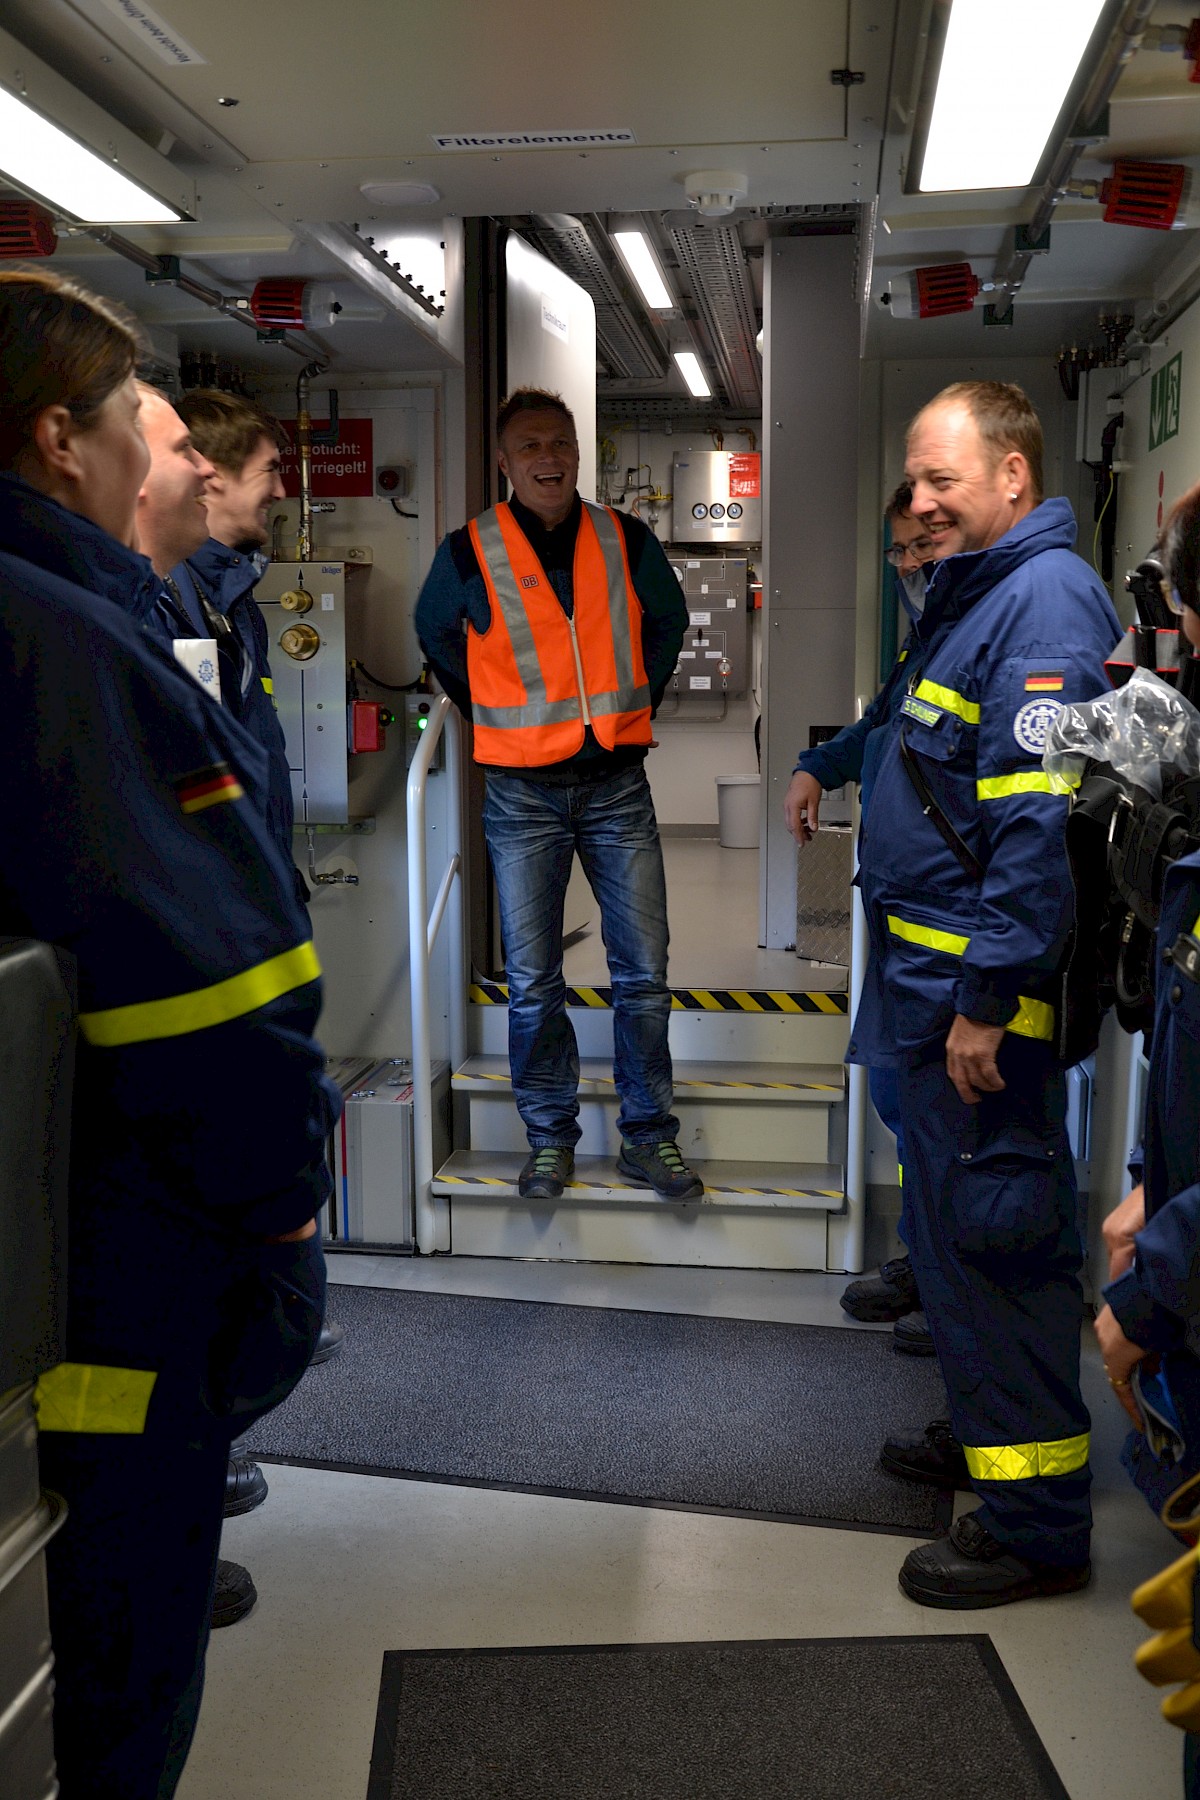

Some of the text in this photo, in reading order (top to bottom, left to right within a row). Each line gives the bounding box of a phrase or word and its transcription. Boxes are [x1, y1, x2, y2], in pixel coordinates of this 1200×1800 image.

[436, 132, 632, 147] Filterelemente
[310, 442, 361, 455] otlicht:
[522, 576, 538, 587] DB
